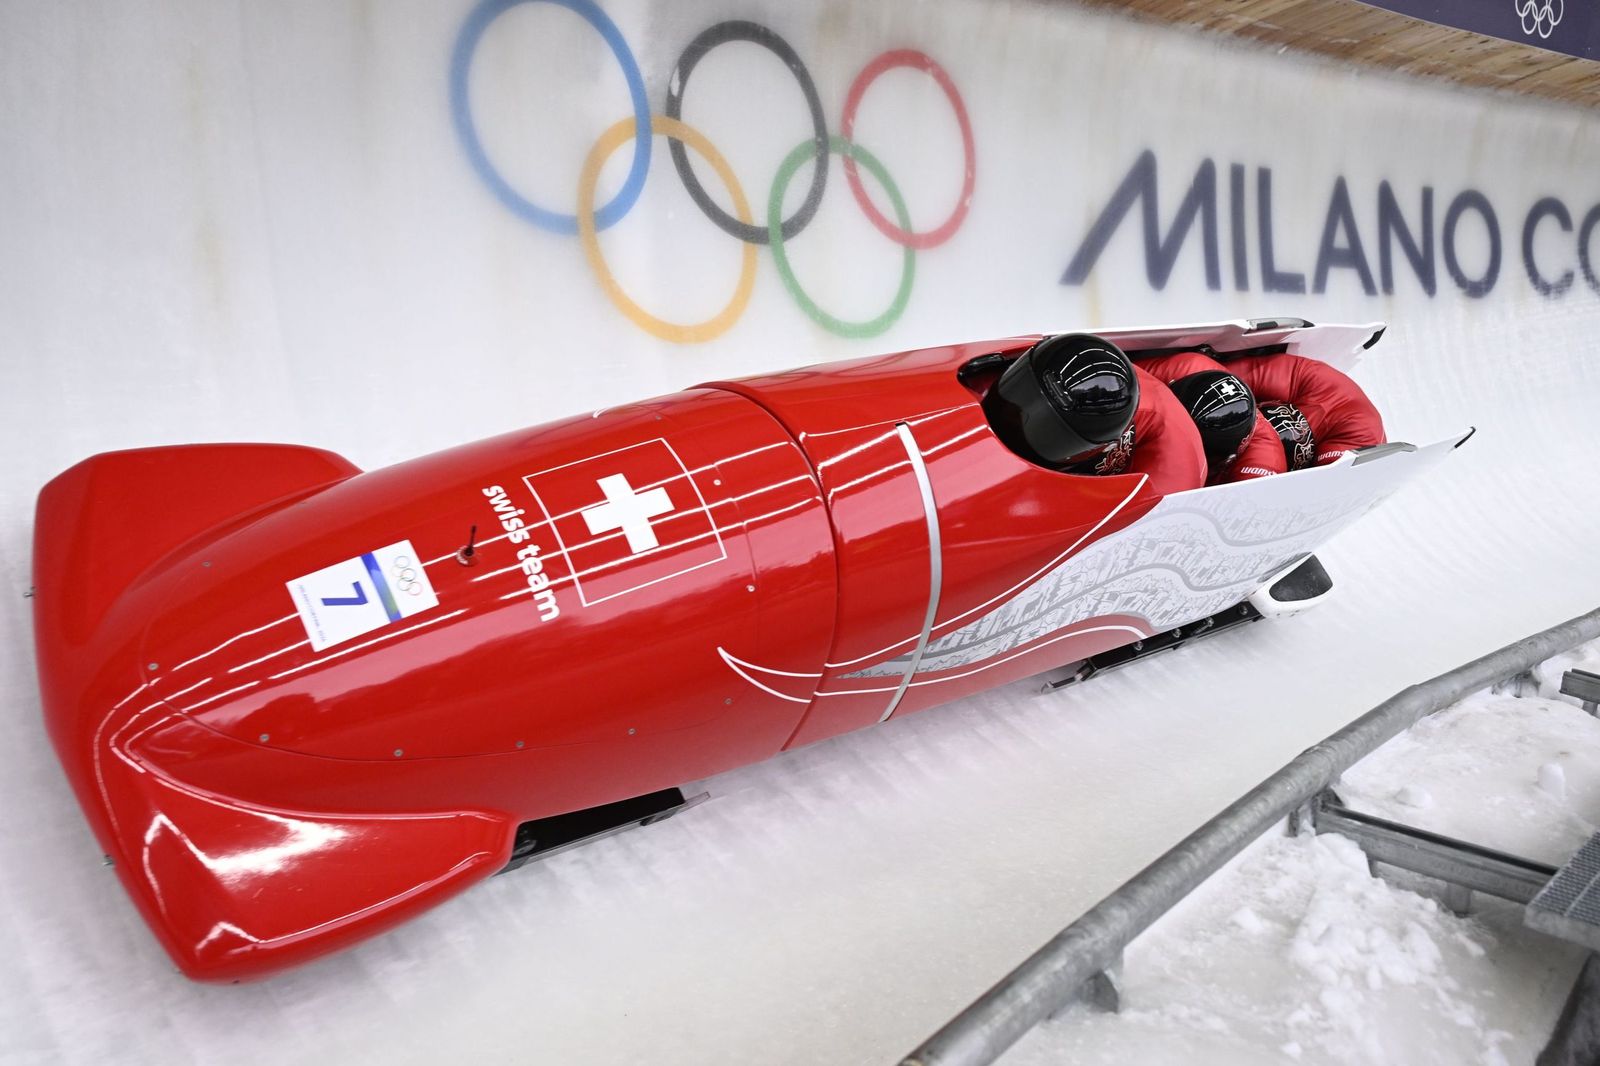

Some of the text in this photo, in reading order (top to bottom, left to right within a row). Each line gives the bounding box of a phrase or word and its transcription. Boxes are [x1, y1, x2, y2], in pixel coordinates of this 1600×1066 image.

[1059, 149, 1502, 298] MILANO
[321, 581, 368, 606] 7
[482, 485, 560, 622] swiss team
